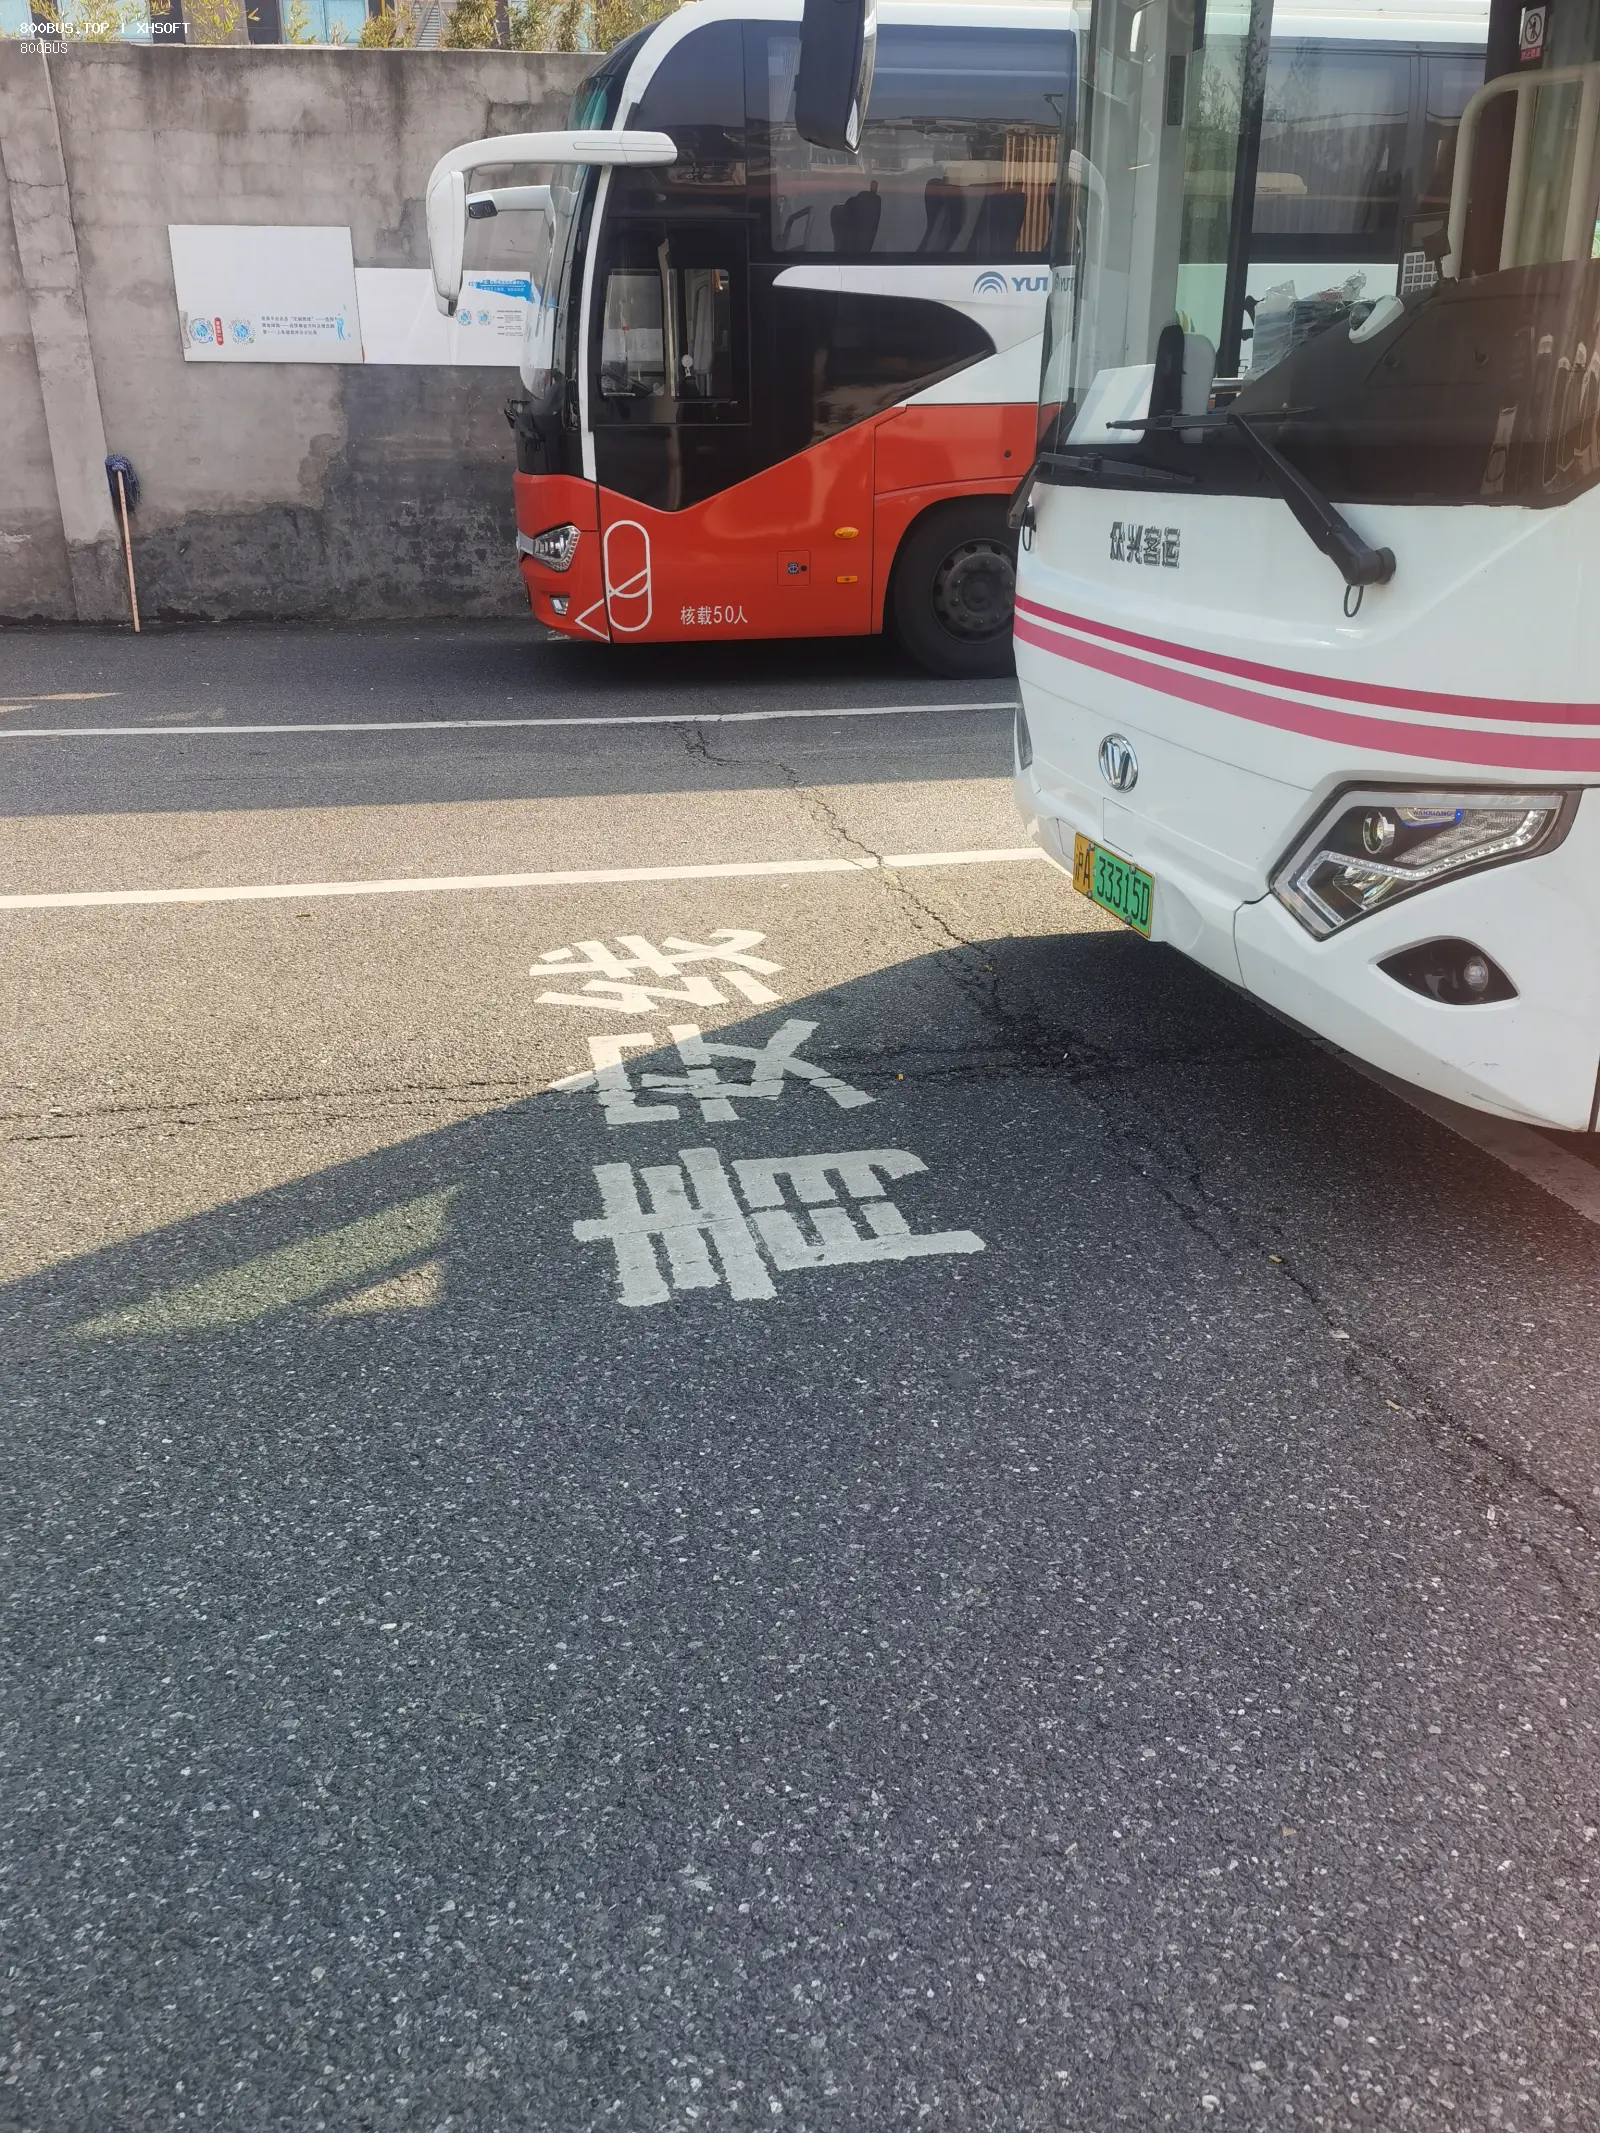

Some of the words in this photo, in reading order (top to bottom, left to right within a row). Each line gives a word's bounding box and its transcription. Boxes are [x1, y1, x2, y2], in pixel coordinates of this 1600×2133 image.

[680, 605, 749, 625] 核载50人
[528, 928, 987, 1307] 青安线
